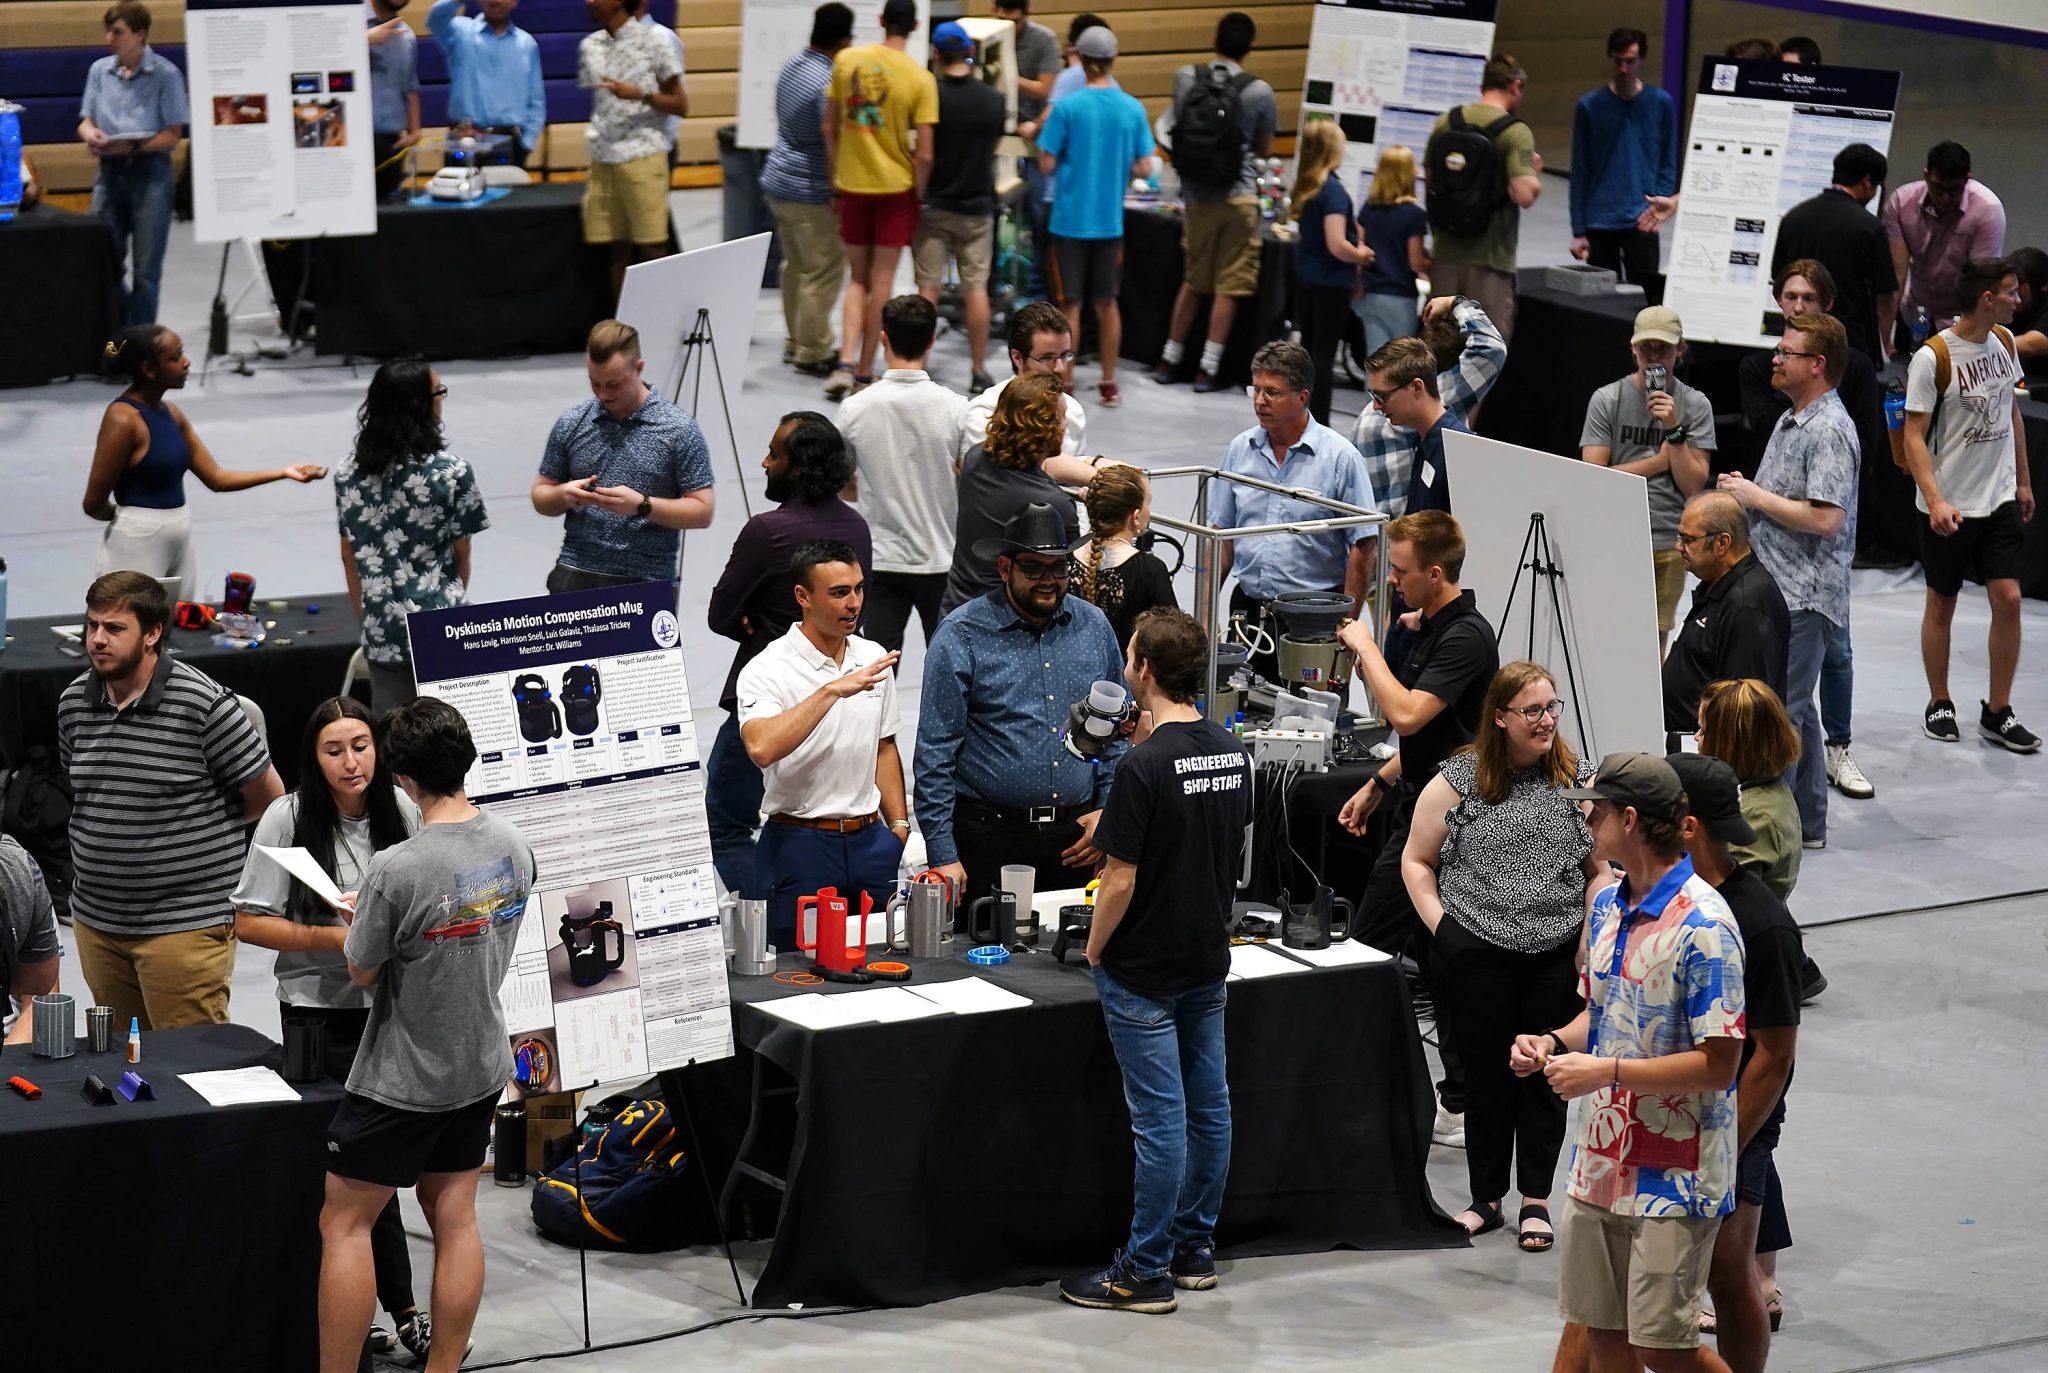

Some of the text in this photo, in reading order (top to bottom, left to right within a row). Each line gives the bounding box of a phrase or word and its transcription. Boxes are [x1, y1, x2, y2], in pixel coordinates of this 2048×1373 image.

[1956, 350, 2014, 395] AMERICAN
[1620, 425, 1663, 446] PUM
[445, 601, 643, 640] Dyskinesia Motion Compensation Mug
[464, 640, 480, 650] Hans
[500, 635, 527, 645] Harrison
[528, 631, 545, 641] Snell,
[546, 630, 558, 639] Luis
[583, 623, 609, 634] Thalassa
[609, 620, 631, 630] Trickey
[519, 640, 582, 655] Mentor: Dr. Williams
[617, 657, 636, 666] Project
[439, 678, 490, 691] Project Description
[1174, 752, 1245, 775] ENGINEERING
[1212, 774, 1242, 792] STAFF
[643, 867, 700, 883] Engineering Standards
[674, 1014, 703, 1025] References
